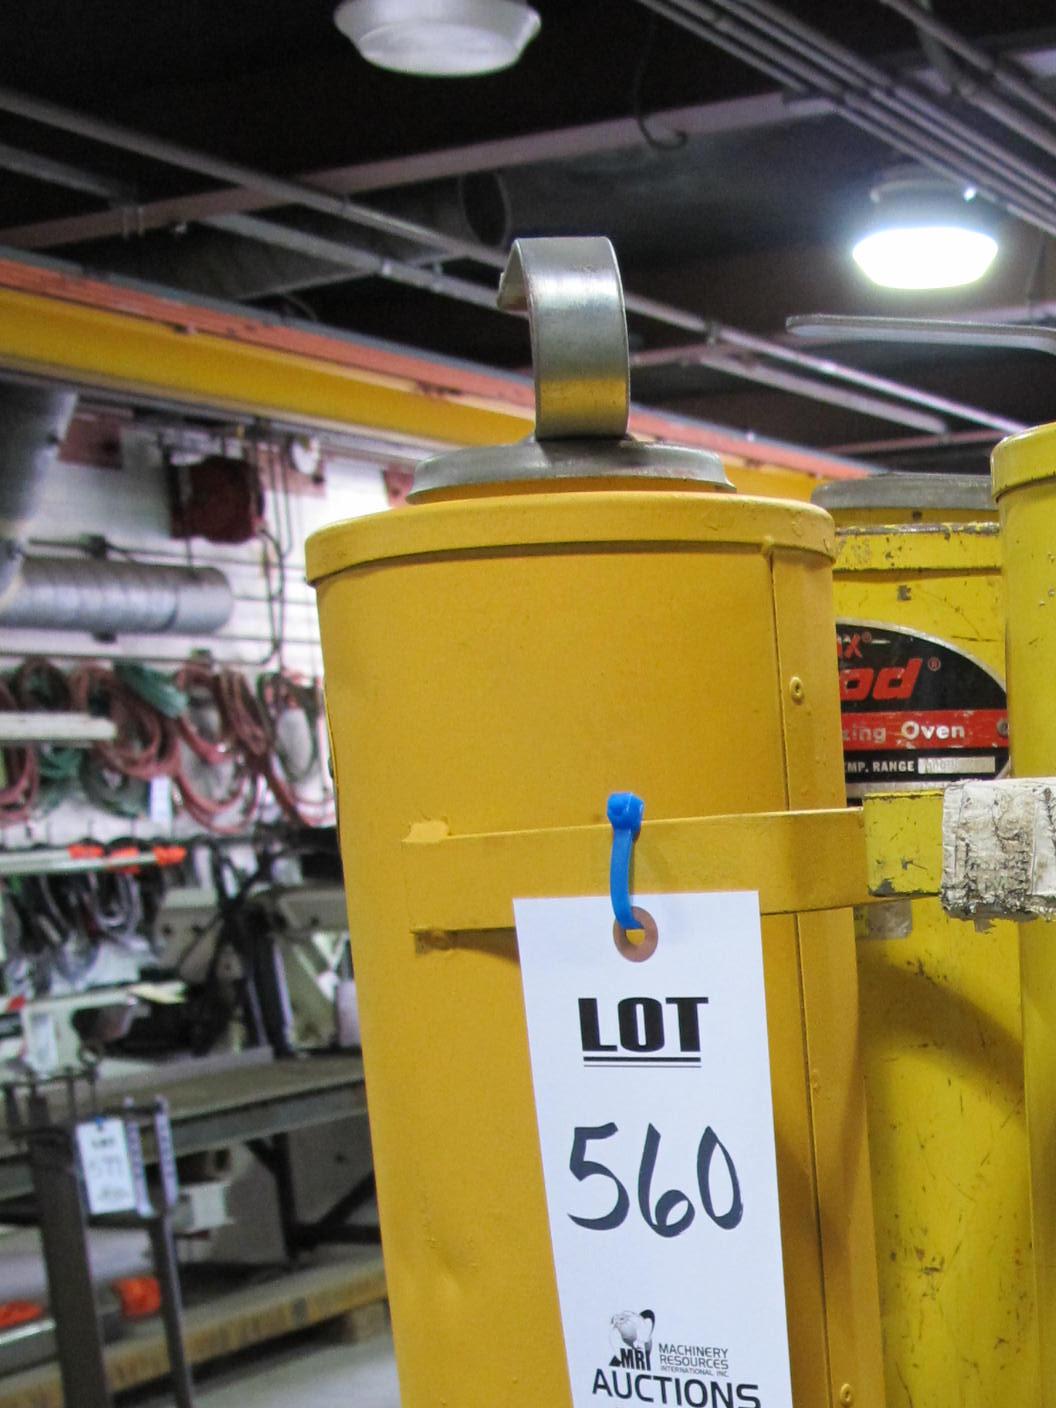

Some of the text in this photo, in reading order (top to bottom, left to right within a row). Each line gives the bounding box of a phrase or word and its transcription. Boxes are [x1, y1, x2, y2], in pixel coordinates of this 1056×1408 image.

[901, 720, 965, 740] Oven
[872, 760, 915, 773] RANGE
[577, 995, 710, 1054] LOT
[566, 1121, 744, 1239] 560
[658, 1343, 729, 1360] MACHINERY
[659, 1355, 729, 1370] RESOURCES
